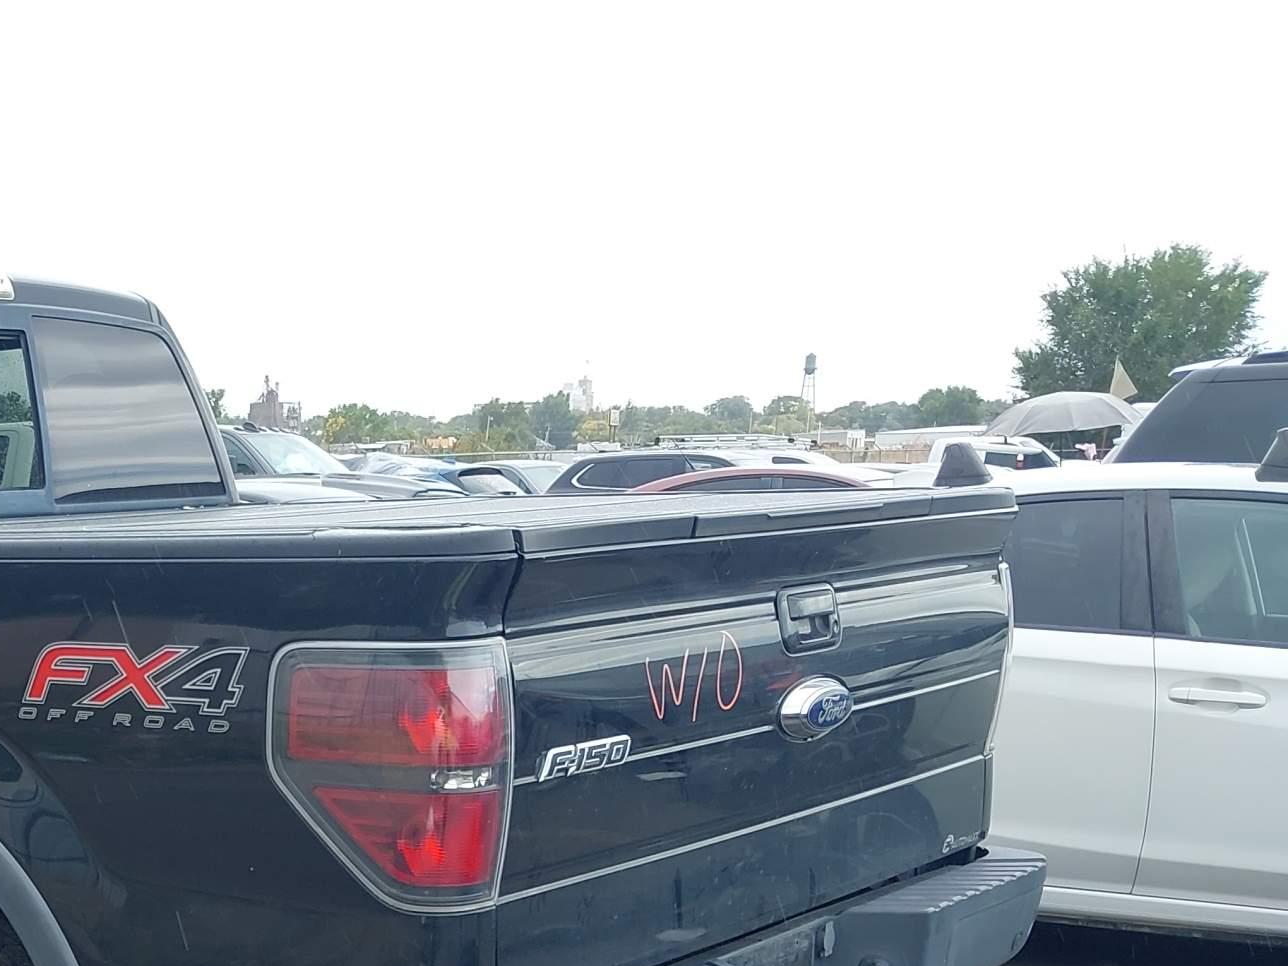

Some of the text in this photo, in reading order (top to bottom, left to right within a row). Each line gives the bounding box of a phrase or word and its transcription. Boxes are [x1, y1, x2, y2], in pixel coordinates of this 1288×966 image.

[22, 641, 250, 716] FX4
[18, 707, 230, 733] OFF ROAD
